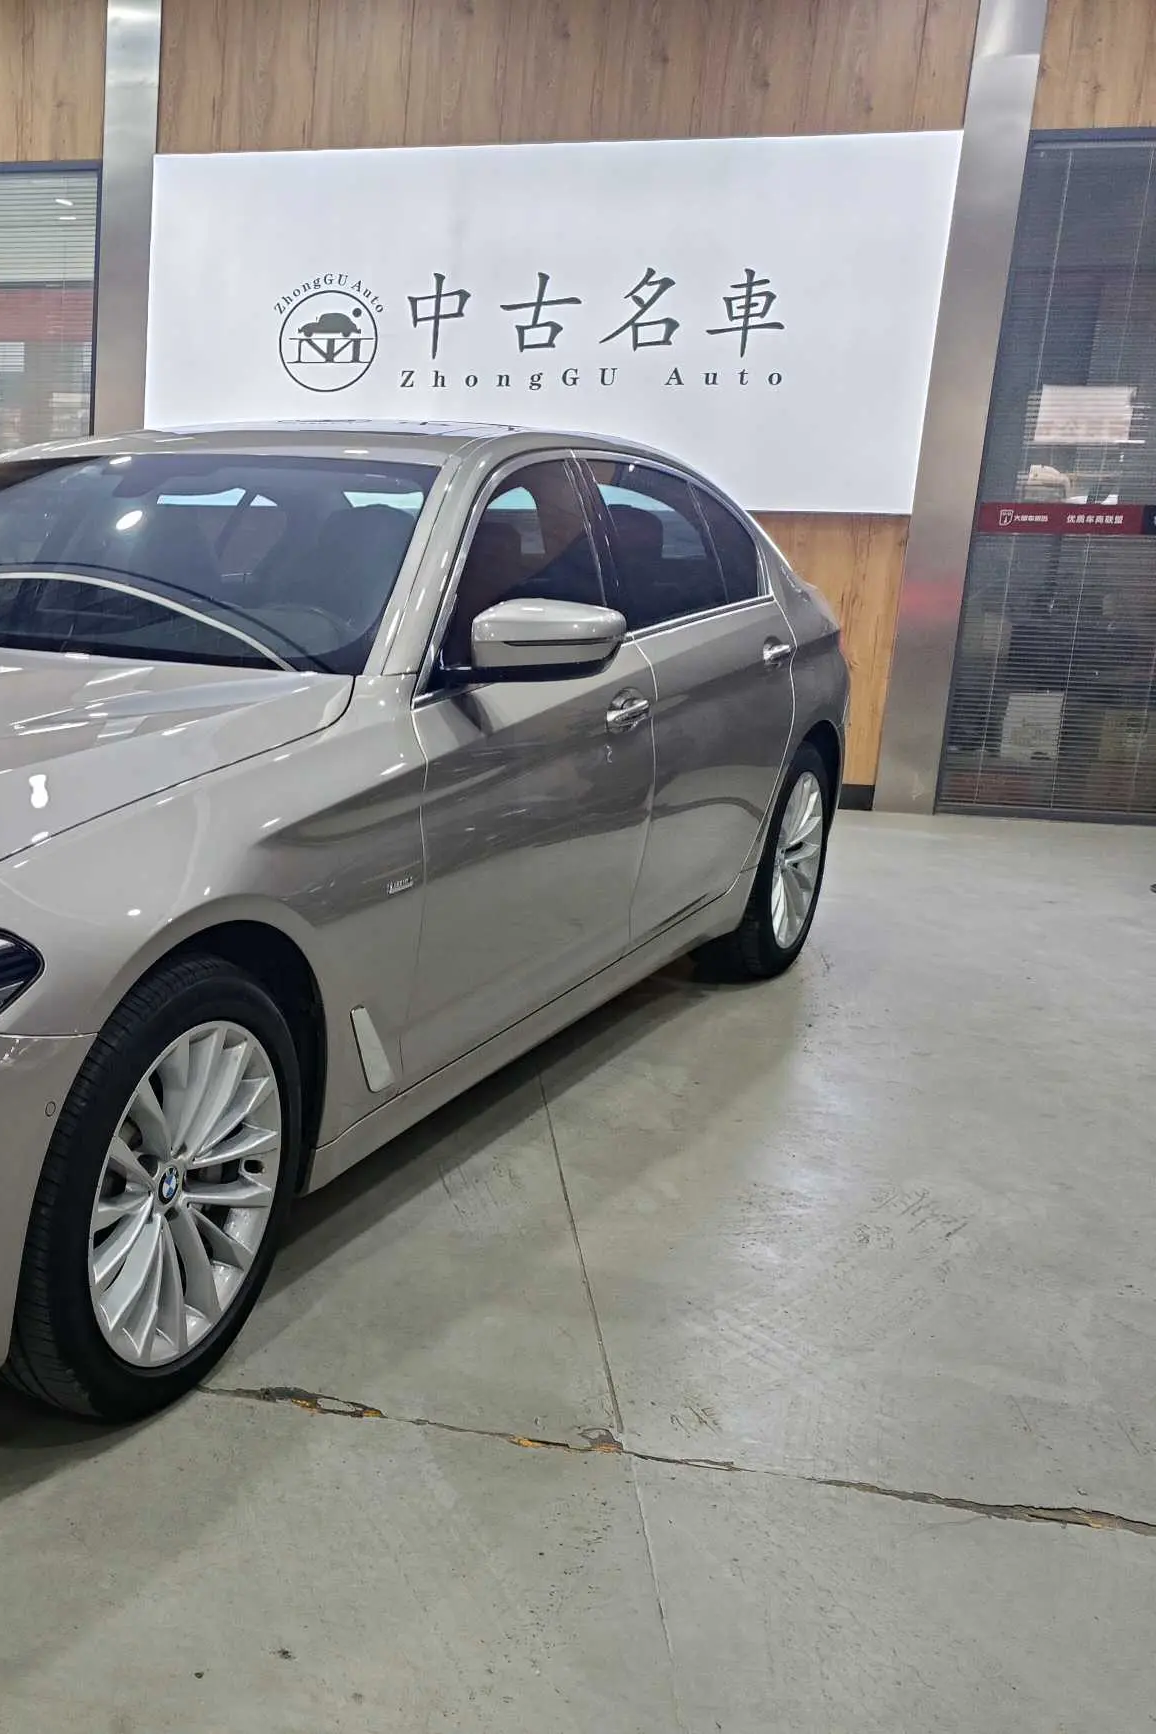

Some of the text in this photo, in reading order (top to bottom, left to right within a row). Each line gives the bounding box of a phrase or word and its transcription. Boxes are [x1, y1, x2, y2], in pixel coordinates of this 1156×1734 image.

[274, 273, 384, 315] ZhongGU Auto
[407, 267, 785, 360] 中古名車
[400, 367, 784, 391] ZhongGU Auto
